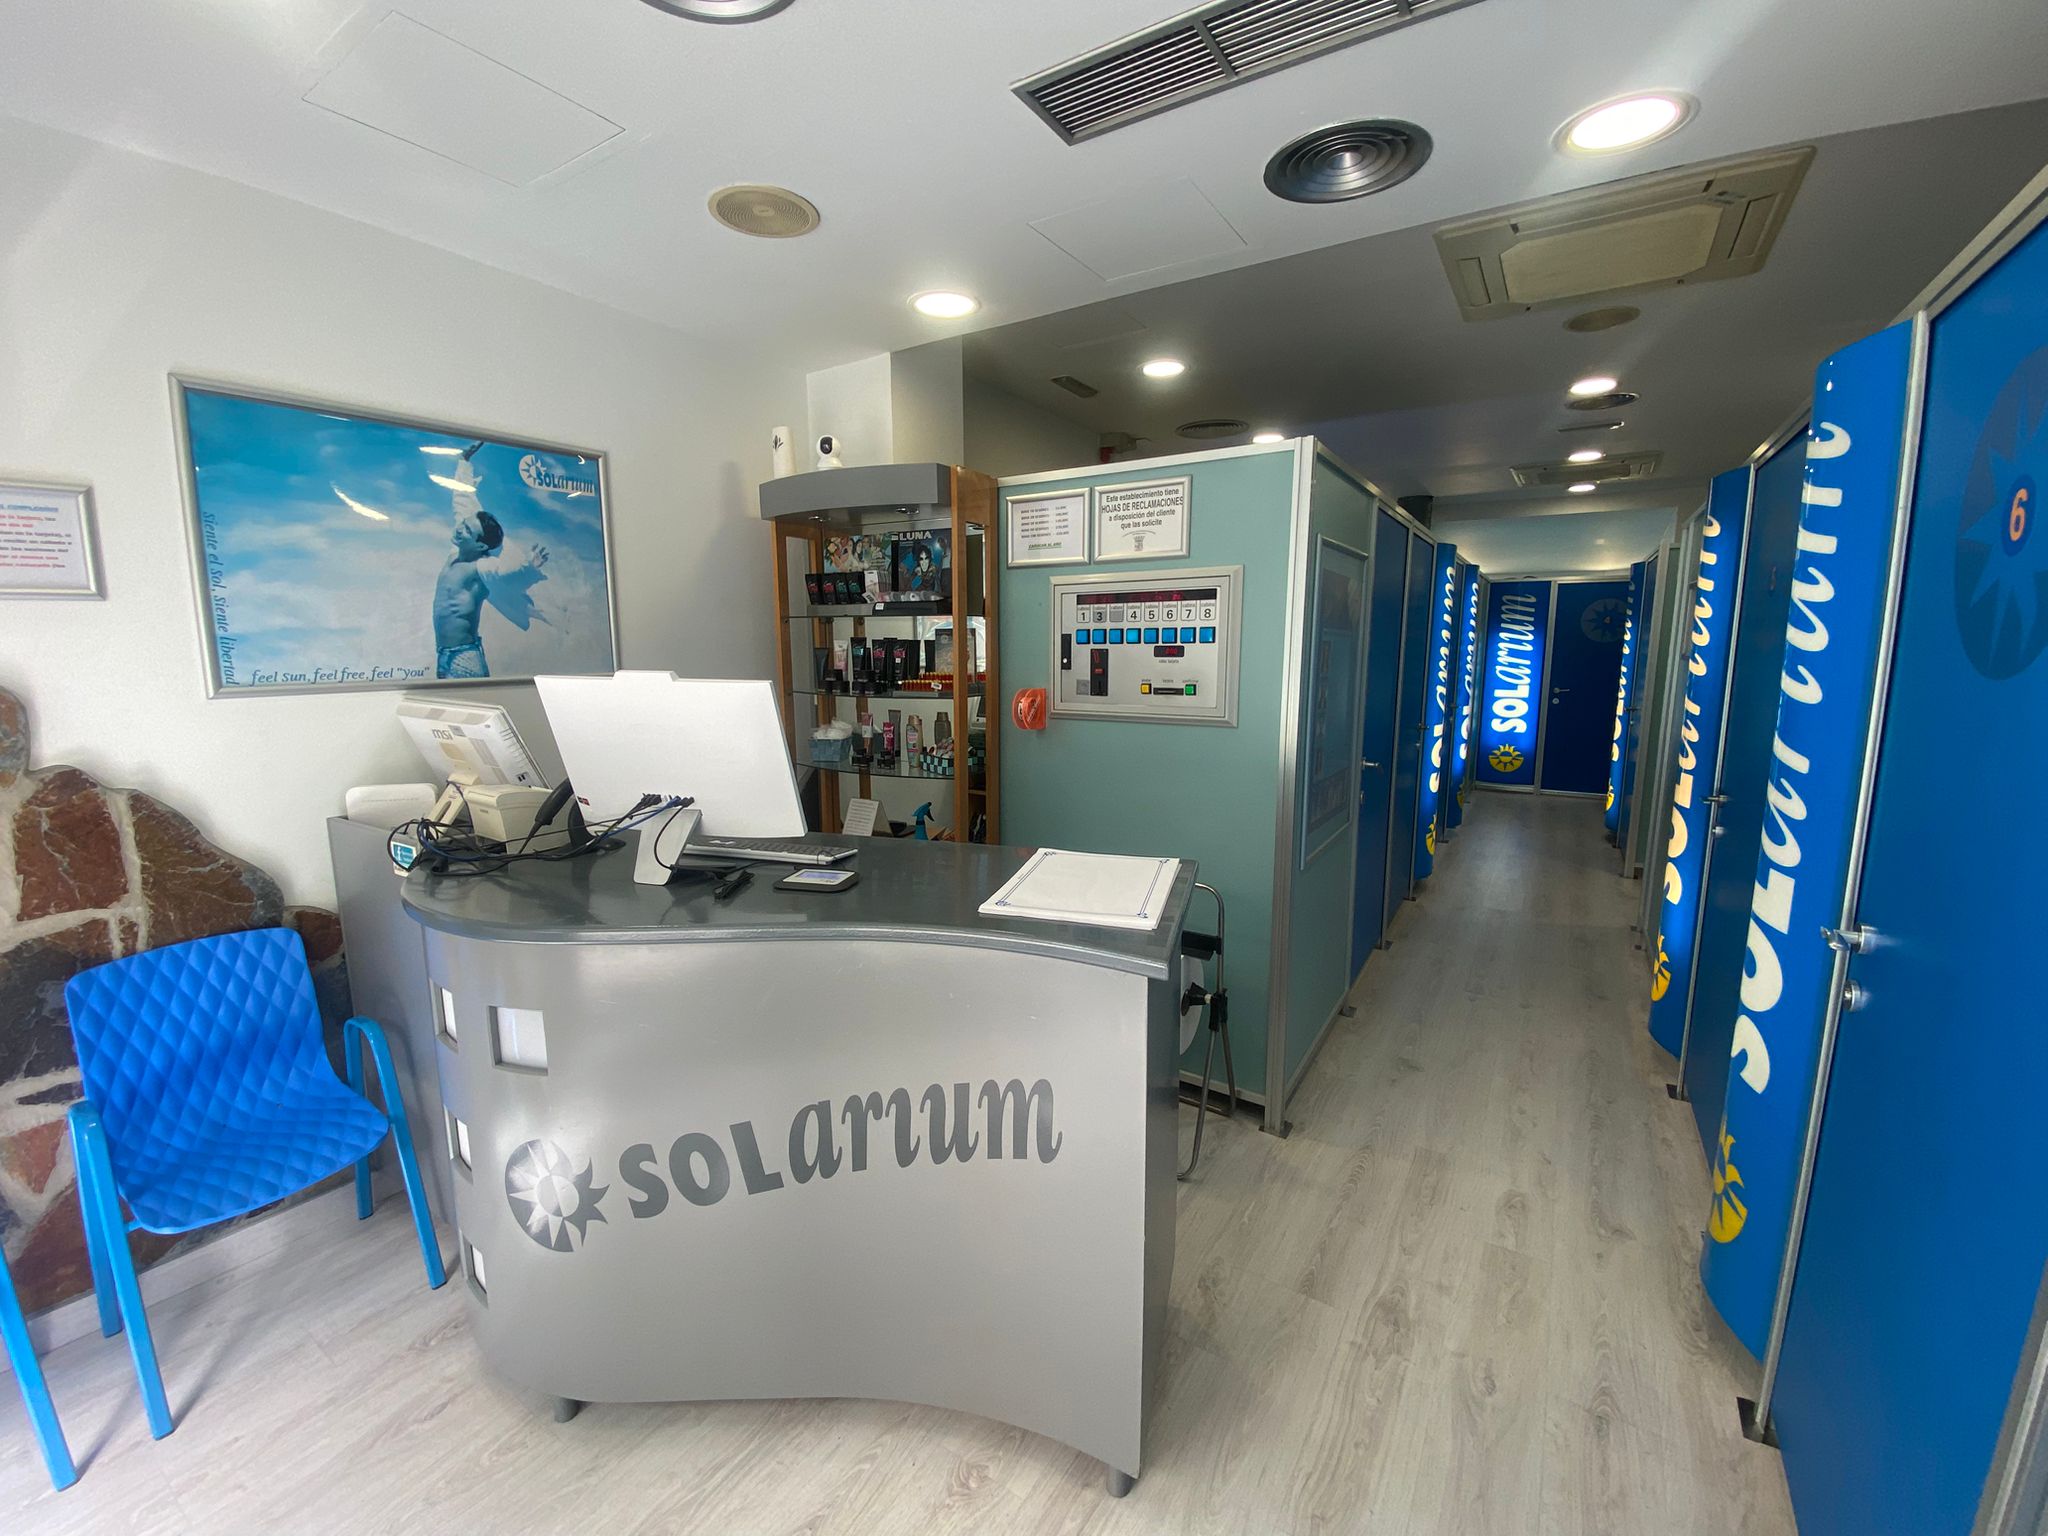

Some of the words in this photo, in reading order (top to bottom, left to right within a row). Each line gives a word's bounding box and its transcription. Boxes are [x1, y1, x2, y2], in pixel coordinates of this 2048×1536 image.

[1106, 495, 1118, 503] Este
[1120, 490, 1163, 500] establecimiento
[1164, 488, 1179, 496] tiene
[1101, 503, 1121, 514] HOJAS
[1122, 502, 1130, 512] DE
[1131, 496, 1184, 510] RECLAMACIONES
[1113, 511, 1145, 522] disposición
[1146, 510, 1155, 518] del
[1156, 509, 1176, 517] cliente
[2009, 488, 2028, 541] 6
[1120, 522, 1131, 530] que
[1142, 519, 1162, 527] solicite
[899, 530, 933, 541] LUNA
[208, 553, 224, 566] el
[218, 636, 241, 686] libertad
[1081, 612, 1086, 621] 1
[1096, 611, 1103, 621] 3
[1130, 610, 1138, 620] 4
[1148, 610, 1155, 620] 5
[1166, 609, 1174, 619] 6
[1185, 609, 1192, 618] 7
[1204, 608, 1212, 618] 8
[1490, 593, 1537, 733] SOLarium
[249, 669, 279, 687] feel
[311, 667, 337, 684] feel
[368, 666, 394, 682] feel
[397, 666, 431, 681] "you"
[431, 727, 454, 741] msi
[618, 1078, 1063, 1219] SOLarium
